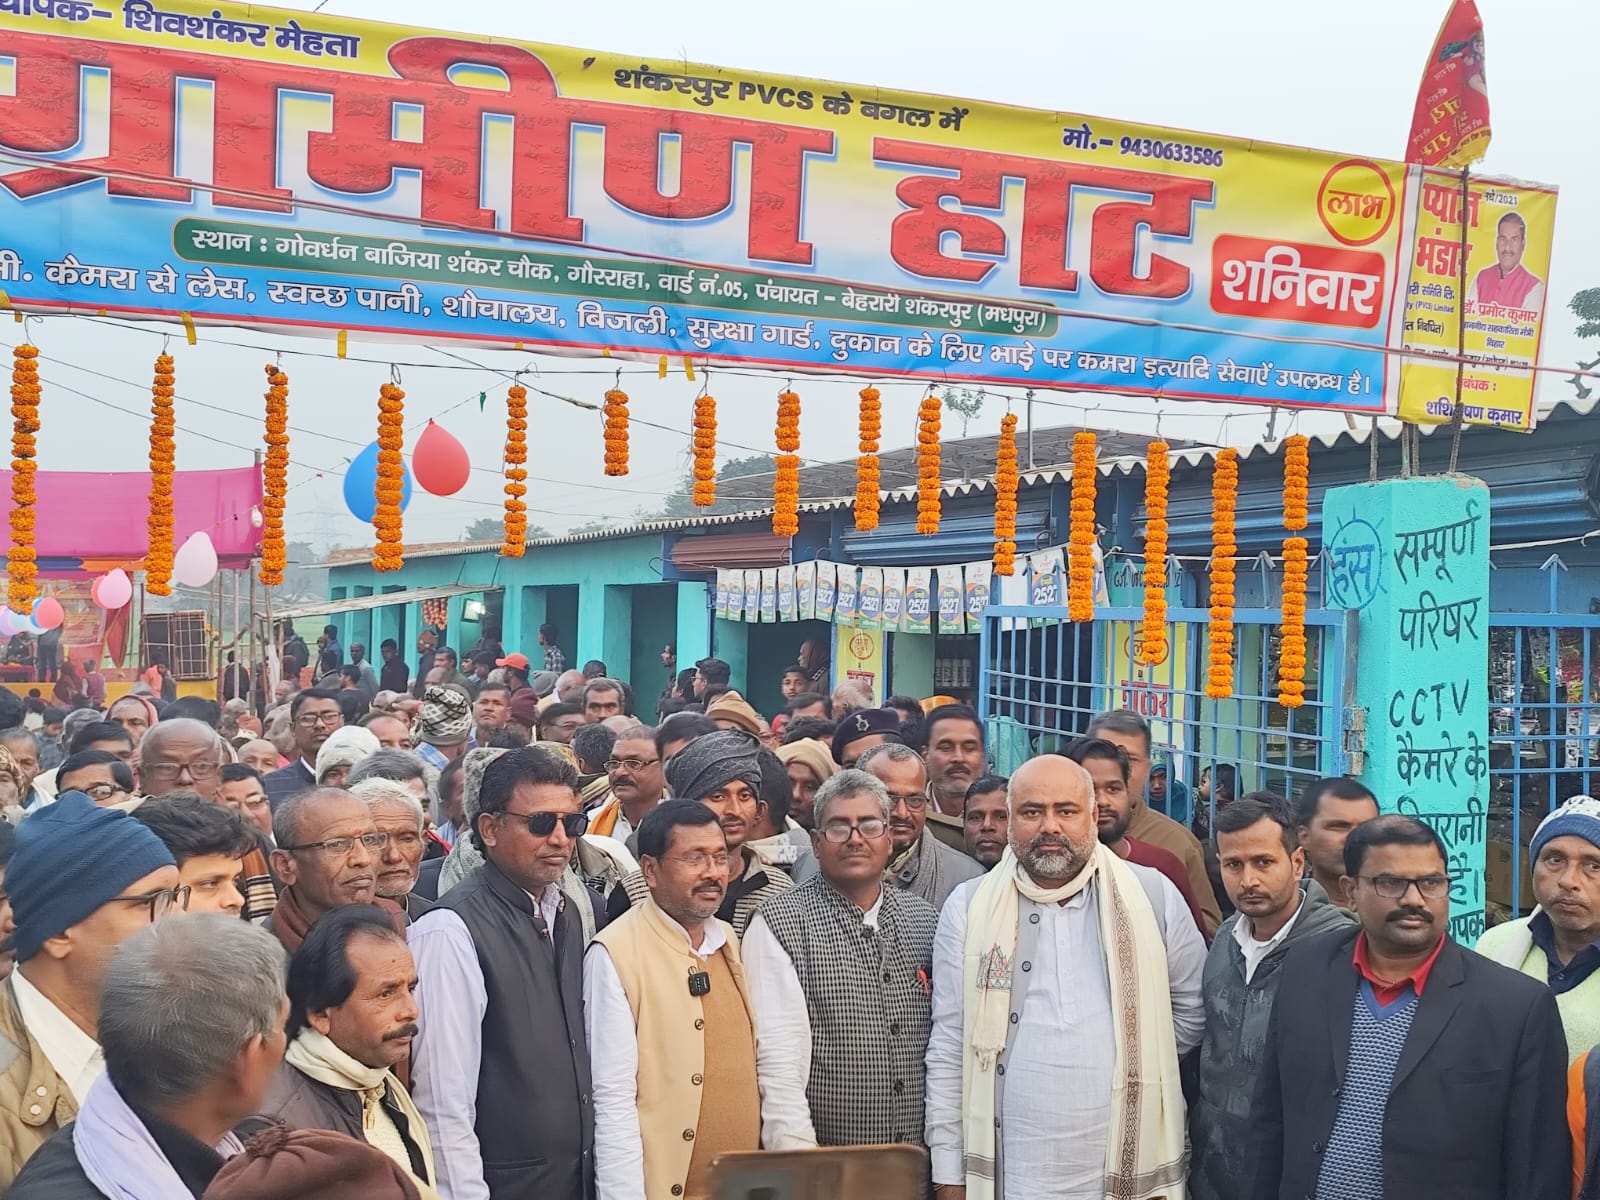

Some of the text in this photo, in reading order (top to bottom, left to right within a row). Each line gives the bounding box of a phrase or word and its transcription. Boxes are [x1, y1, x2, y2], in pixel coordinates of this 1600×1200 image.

[123, 0, 269, 46] शिवशंकर
[275, 20, 360, 59] मेहता
[614, 64, 970, 131] शंकरपुर PVCS के बगल में
[1120, 136, 1223, 167] 9430633586
[874, 137, 1214, 299] हाट
[1327, 189, 1387, 220] लाभ
[191, 230, 253, 252] स्थान
[275, 233, 358, 262] गोवर्धन
[364, 242, 442, 271] बाजिया
[447, 250, 503, 277] शंकर
[507, 254, 560, 283] चौक,
[658, 270, 695, 295] वार्ड
[755, 278, 820, 306] पंचायत
[905, 297, 973, 328] शंकरपुर
[1221, 245, 1380, 315] शनिवार
[45, 254, 138, 291] कैमरा
[147, 263, 179, 294] से
[267, 280, 351, 308] स्वच्छ
[354, 282, 432, 318] पानी,
[442, 288, 567, 329] शौचालय,
[576, 300, 677, 338] बिजली,
[686, 317, 756, 349] सुरक्षा
[762, 321, 821, 351] गार्ड,
[829, 329, 902, 361] दुकान
[907, 332, 938, 357] के
[939, 333, 985, 363] लिए
[1042, 348, 1073, 369] पर
[1077, 351, 1137, 374] कमरा
[1142, 355, 1211, 381] इत्यादि
[1275, 369, 1343, 391] उपलब्ध
[1479, 302, 1506, 318] प्रमोद
[1508, 309, 1538, 325] कुमार
[1426, 396, 1523, 426] शशिषण कुमार
[1394, 499, 1482, 584] सम्पूर्ण
[861, 596, 880, 611] 2527
[908, 599, 930, 614] 2527
[939, 598, 959, 614] 2527
[1389, 678, 1470, 728] CCTV
[1396, 730, 1487, 788] कैमरे के
